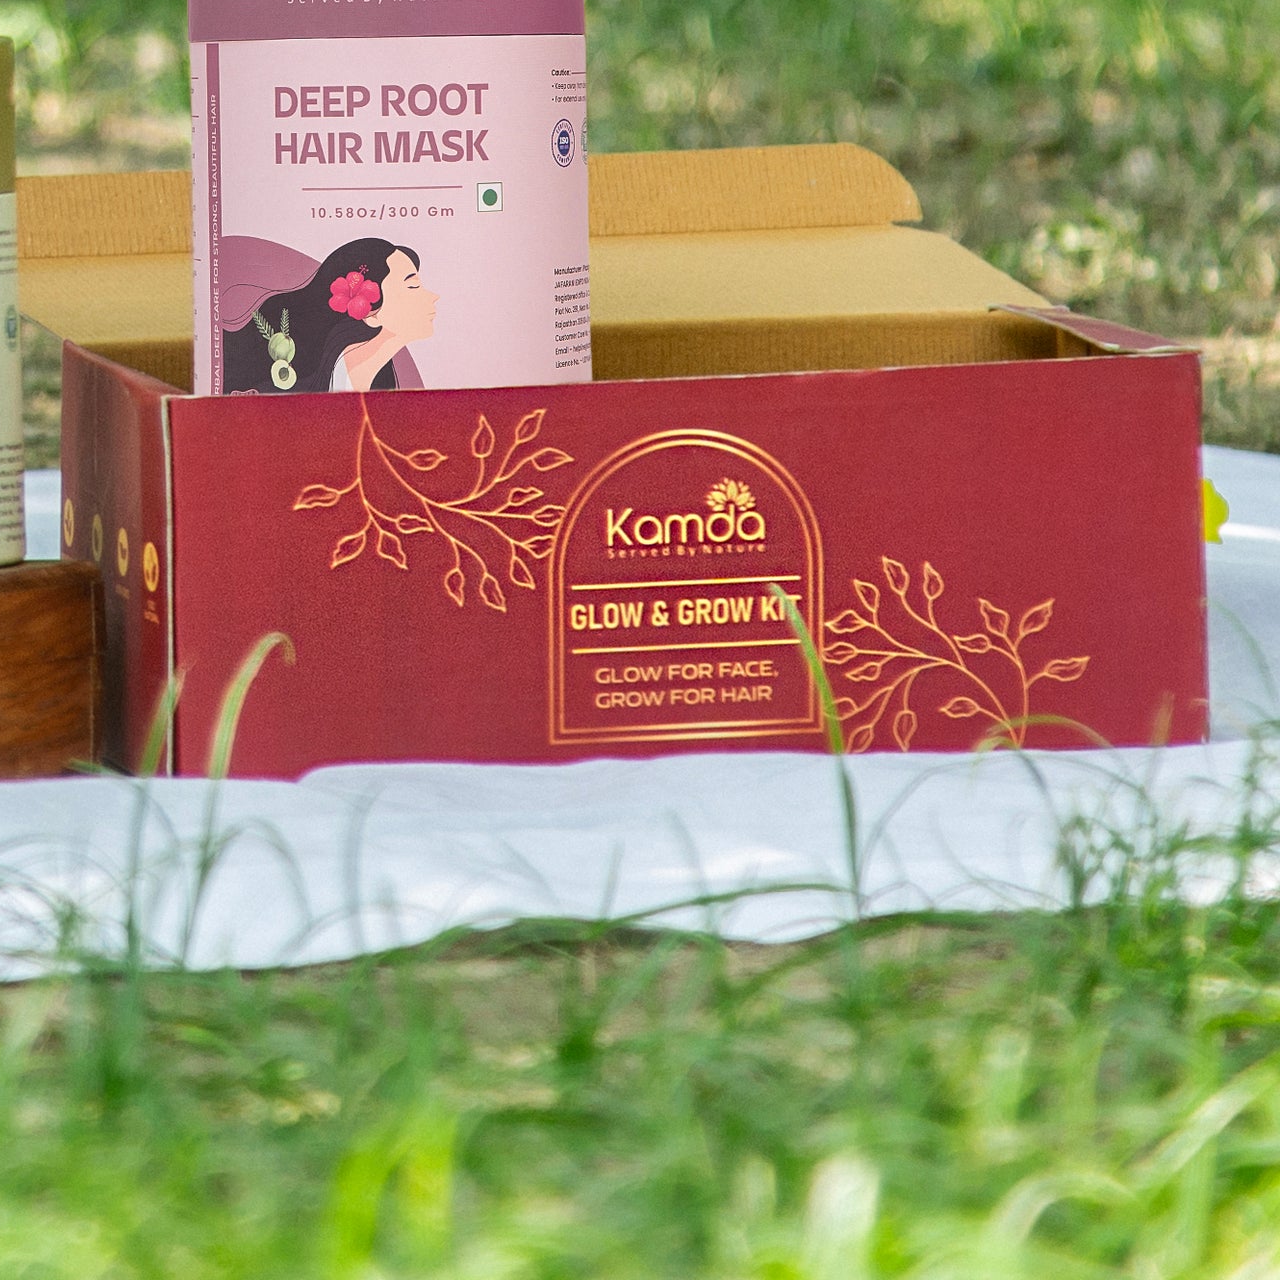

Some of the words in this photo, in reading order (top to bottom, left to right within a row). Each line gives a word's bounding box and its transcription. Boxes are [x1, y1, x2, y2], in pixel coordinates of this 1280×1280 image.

[274, 86, 370, 118] DEEP
[381, 83, 488, 117] ROOT
[274, 132, 361, 165] HAIR
[374, 130, 488, 163] MASK
[559, 136, 569, 145] ISO
[427, 206, 454, 217] Gm
[606, 504, 766, 546] Kamda
[607, 547, 671, 559] Served
[676, 545, 696, 557] By
[702, 543, 766, 555] Nature
[571, 600, 643, 630] GLOW
[651, 600, 670, 626] &
[678, 597, 753, 625] GROW
[595, 665, 663, 684] GLOW
[668, 664, 714, 681] FOR
[719, 660, 778, 678] FACE,
[595, 690, 666, 708] GROW
[670, 688, 716, 705] FOR
[721, 685, 773, 703] HAIR
